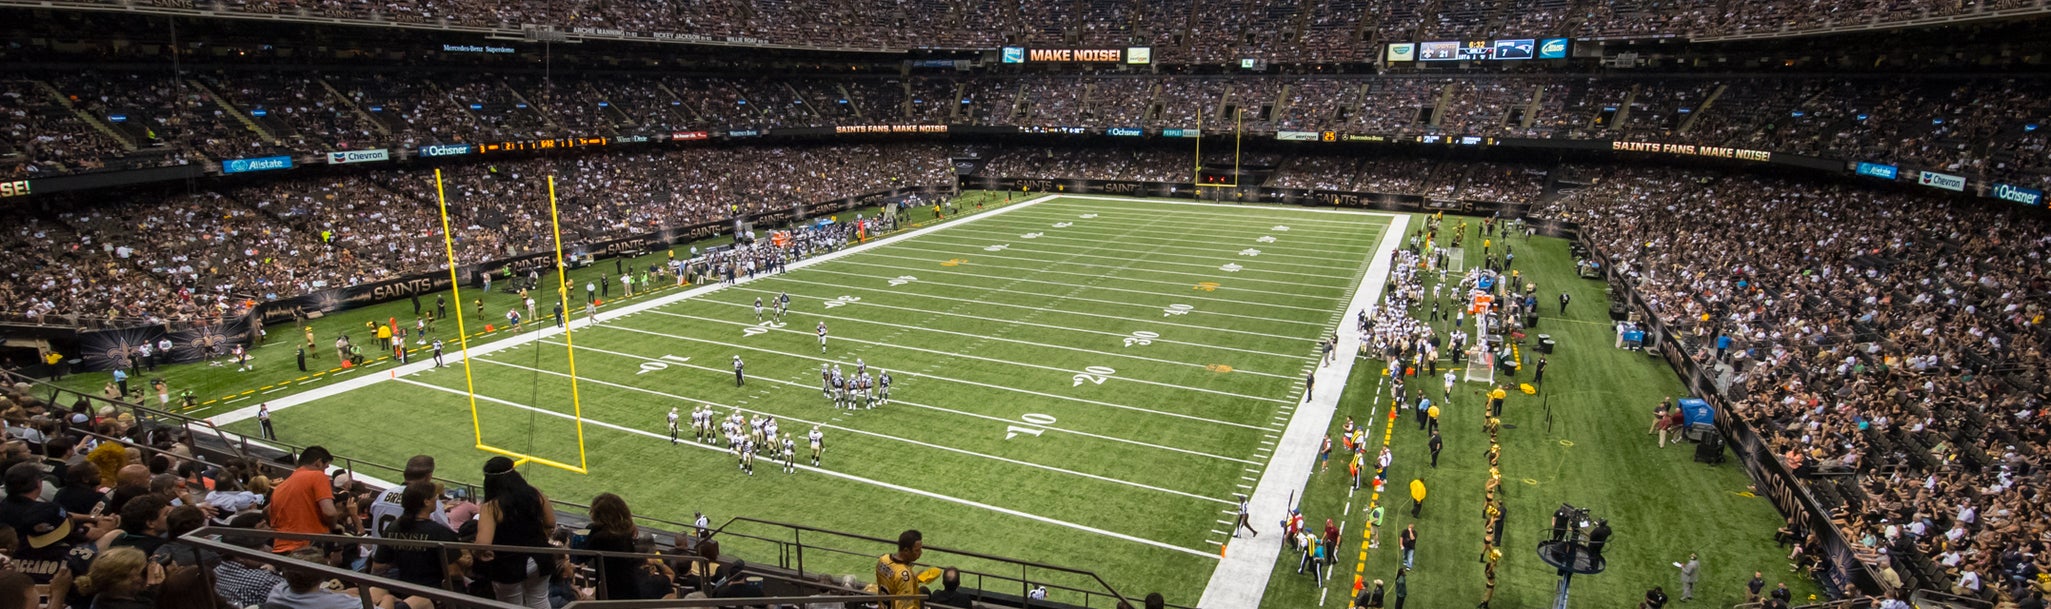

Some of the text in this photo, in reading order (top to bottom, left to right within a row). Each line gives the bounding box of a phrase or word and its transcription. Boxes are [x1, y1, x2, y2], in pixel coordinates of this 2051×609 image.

[443, 44, 483, 52] Mercedes-Benz
[1030, 49, 1070, 61] MAKE
[1074, 49, 1120, 61] NOISE!
[836, 125, 866, 133] SAINTS
[1112, 128, 1140, 136] Ochsner
[1324, 132, 1335, 141] 25
[348, 151, 383, 160] Chevron
[429, 145, 467, 156] Ochsner
[1612, 141, 1660, 151] SAINTS
[1699, 146, 1734, 158] MAKE
[1735, 149, 1771, 162] NOISE!
[249, 159, 283, 169] Allstate
[1016, 179, 1051, 190] SAINTS
[1933, 174, 1960, 188] Chevron
[1105, 183, 1142, 193] SAINT
[1999, 183, 2038, 205] Ochsner
[815, 202, 838, 213] SAINTS
[758, 212, 785, 226] SAINTS
[690, 224, 721, 239] SAINTS
[608, 237, 645, 255] SAINTS
[374, 277, 431, 301] SAINTS
[1072, 365, 1116, 385] 20
[1007, 413, 1057, 438] 10
[1771, 473, 1810, 528] SAINTS
